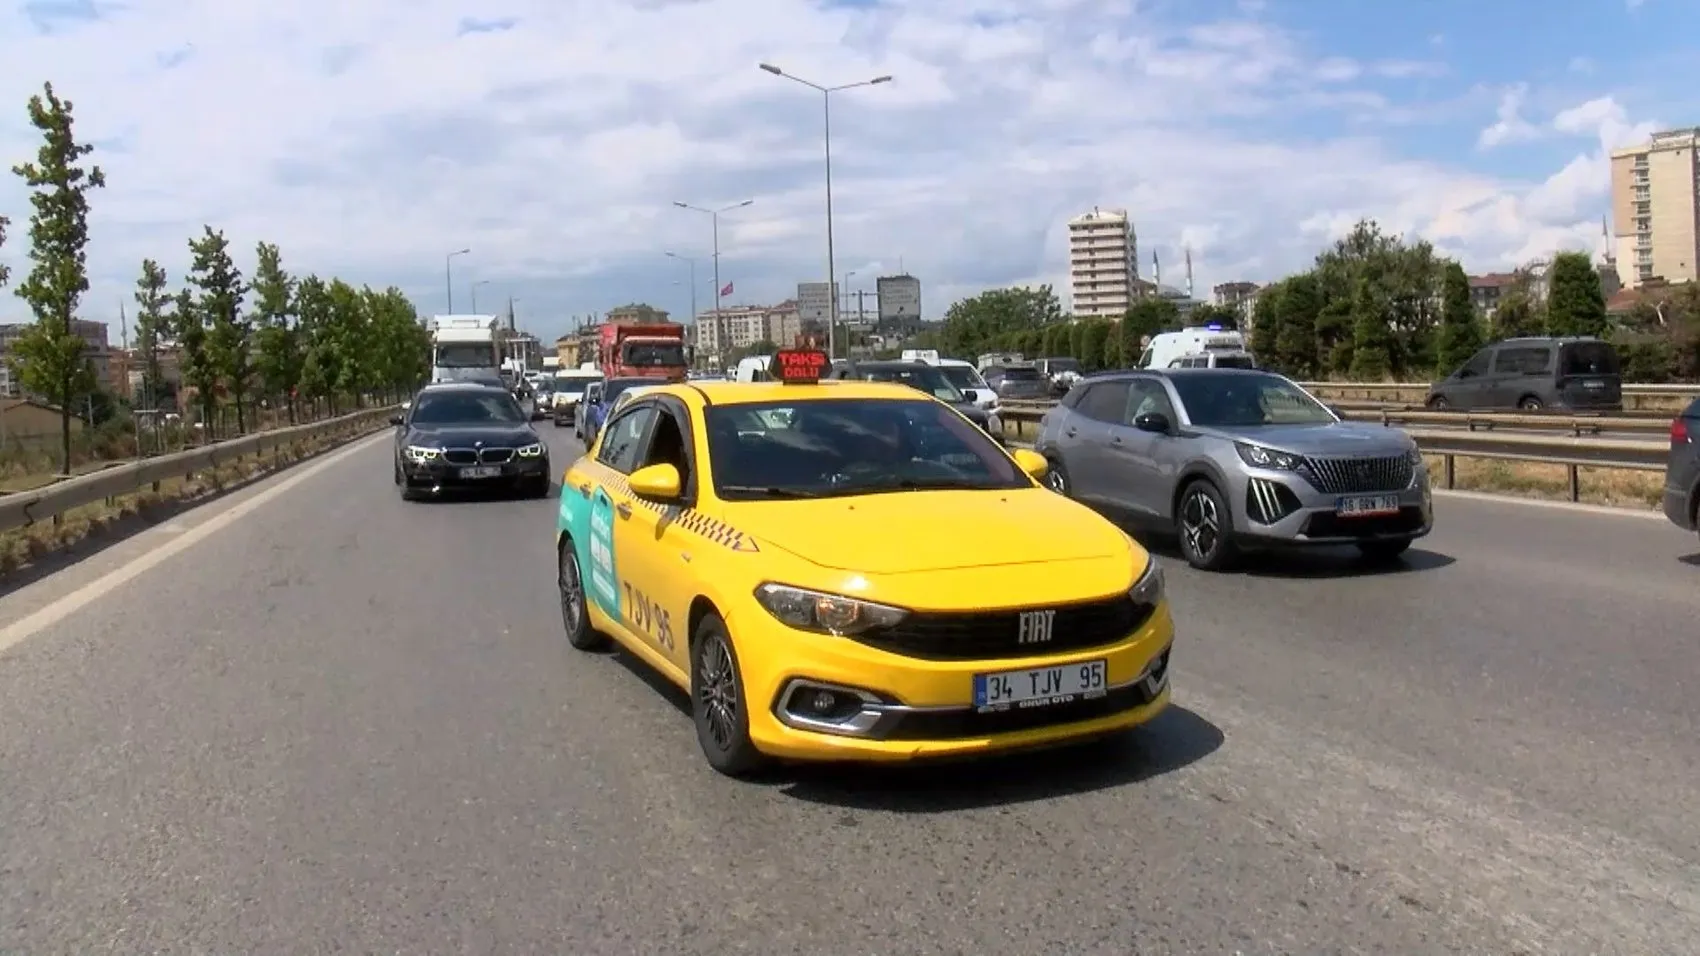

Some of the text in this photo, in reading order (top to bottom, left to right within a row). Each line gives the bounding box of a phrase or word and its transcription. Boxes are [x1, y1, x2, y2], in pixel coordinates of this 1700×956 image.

[784, 367, 819, 378] DOLU
[624, 581, 652, 633] TJV
[655, 602, 674, 650] 95
[1019, 610, 1056, 643] FIAT
[990, 664, 1101, 700] 34 TJV 95
[1052, 694, 1074, 703] OTO
